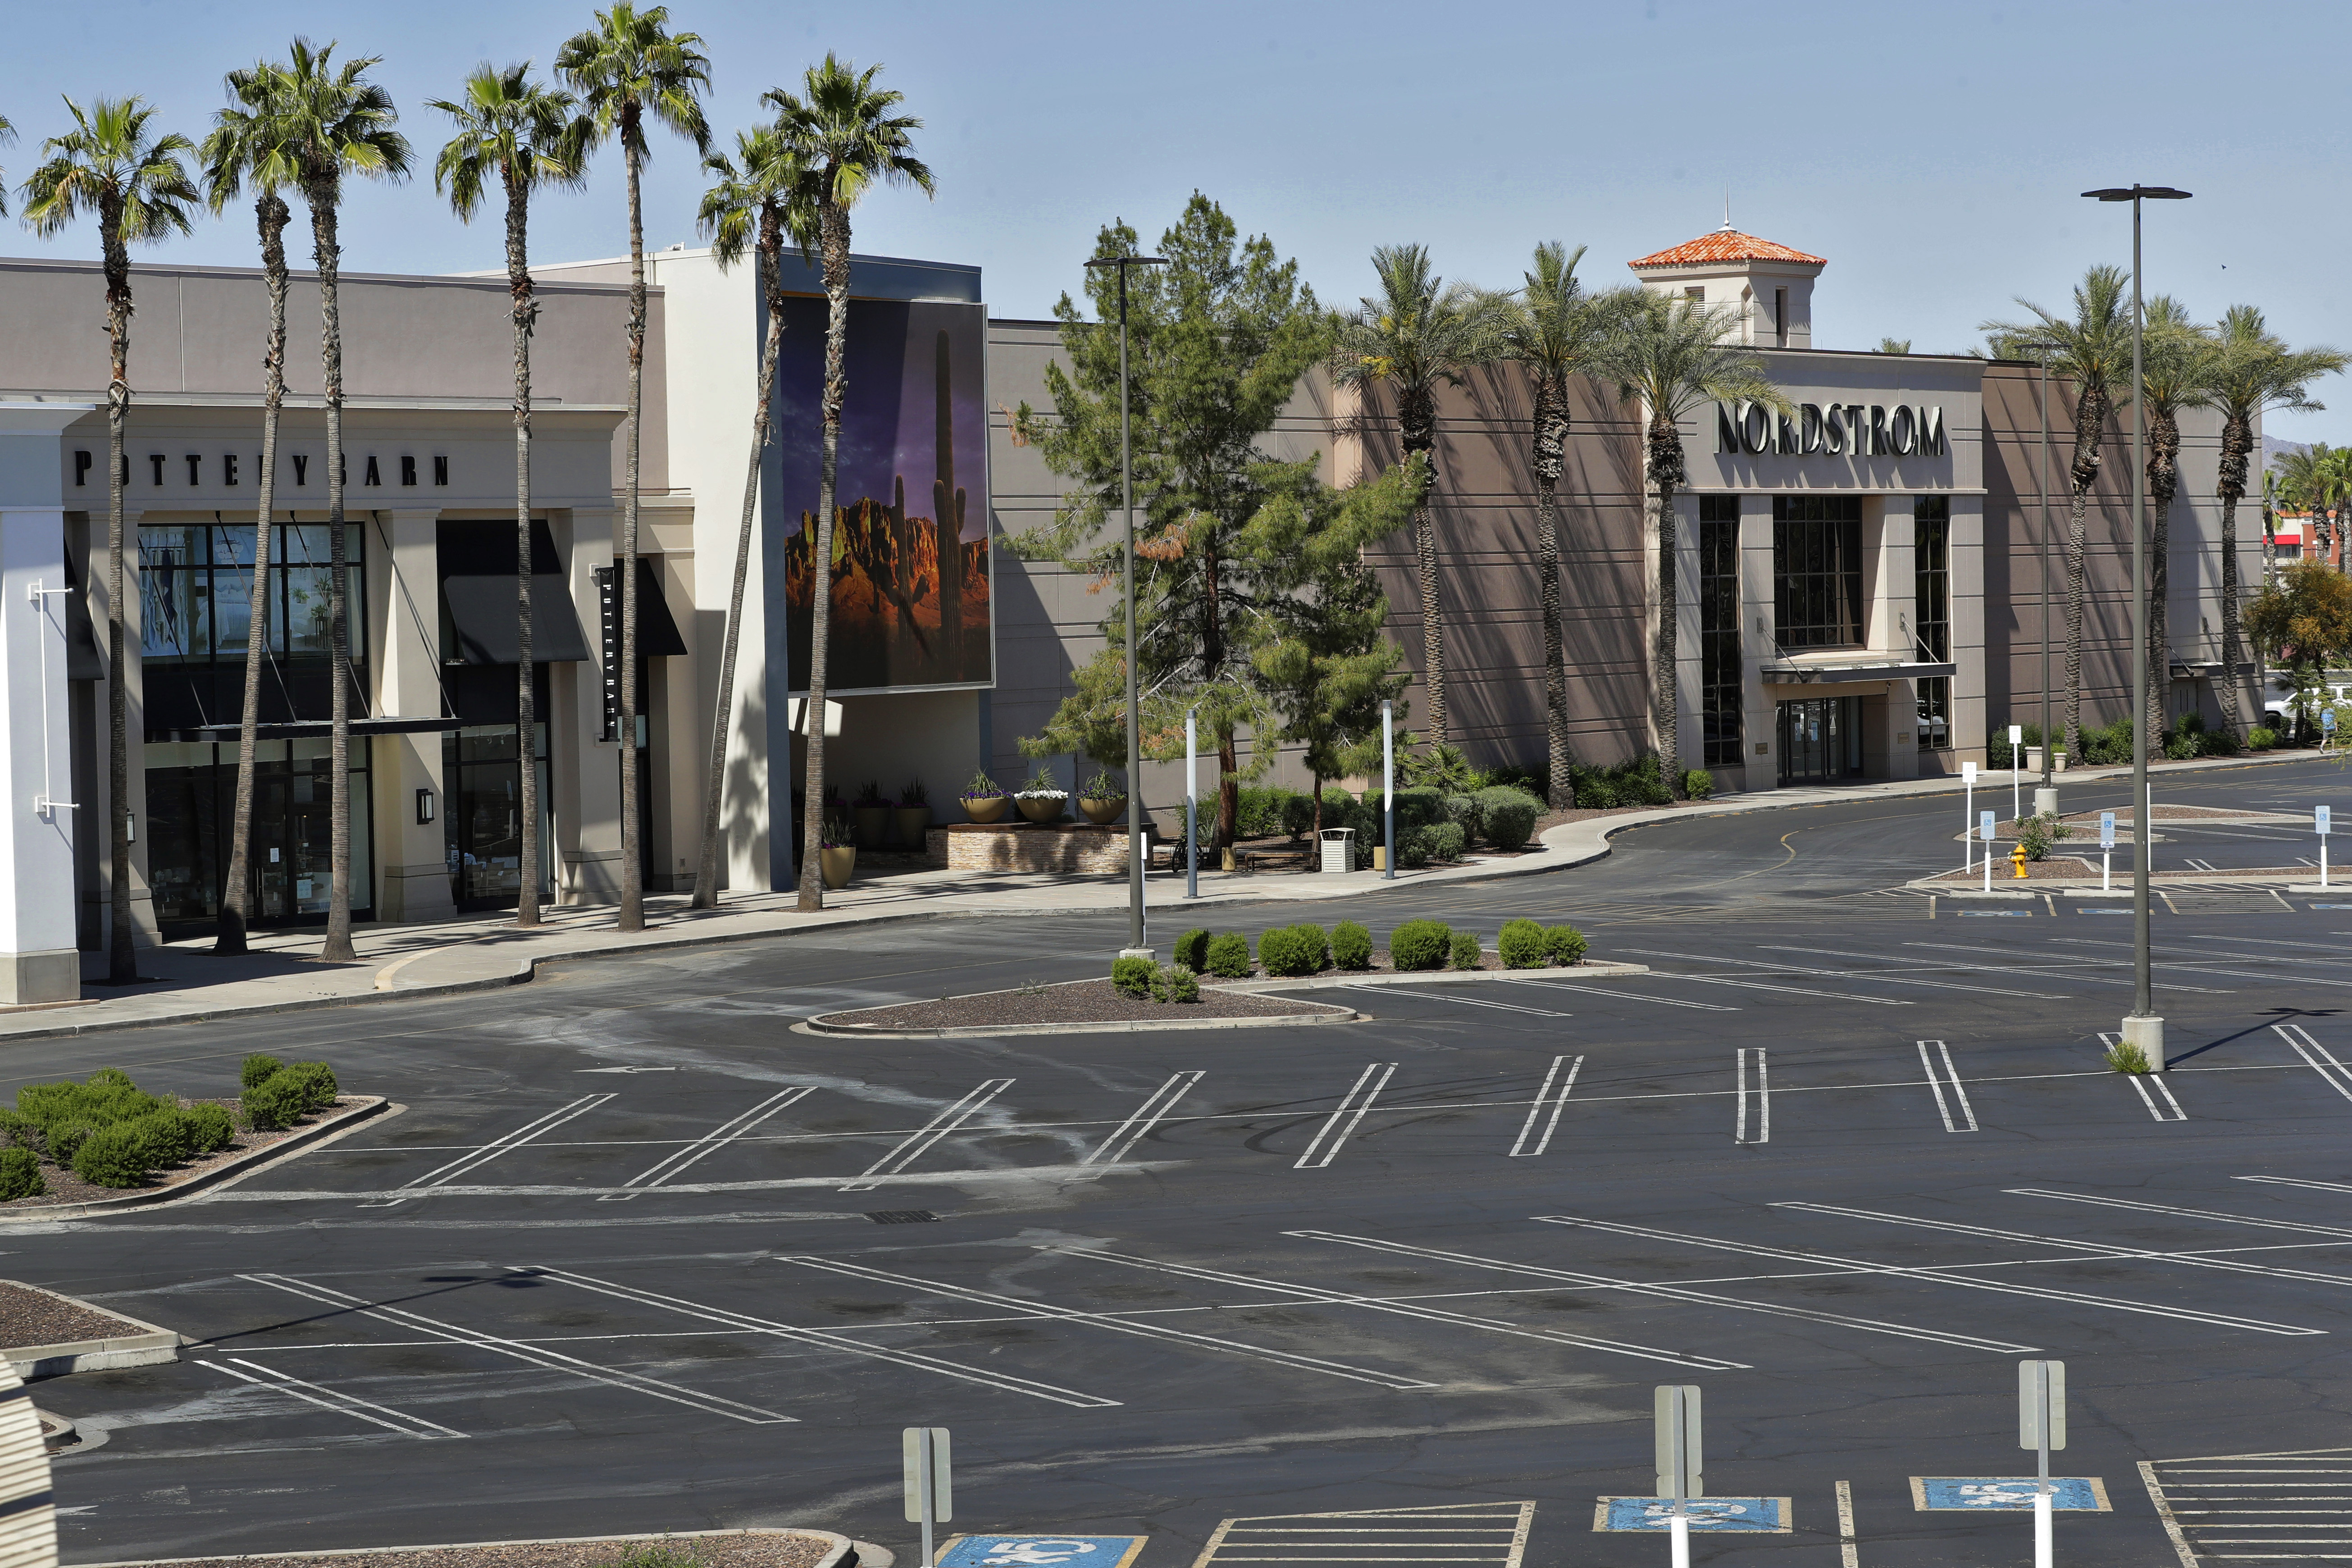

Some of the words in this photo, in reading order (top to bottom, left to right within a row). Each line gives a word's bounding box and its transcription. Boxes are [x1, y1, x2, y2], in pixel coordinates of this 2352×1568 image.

[1713, 402, 1944, 456] NORDSTROM
[75, 451, 309, 485] PTTEY
[603, 584, 614, 670] POTTERY
[606, 679, 615, 727] BARN
